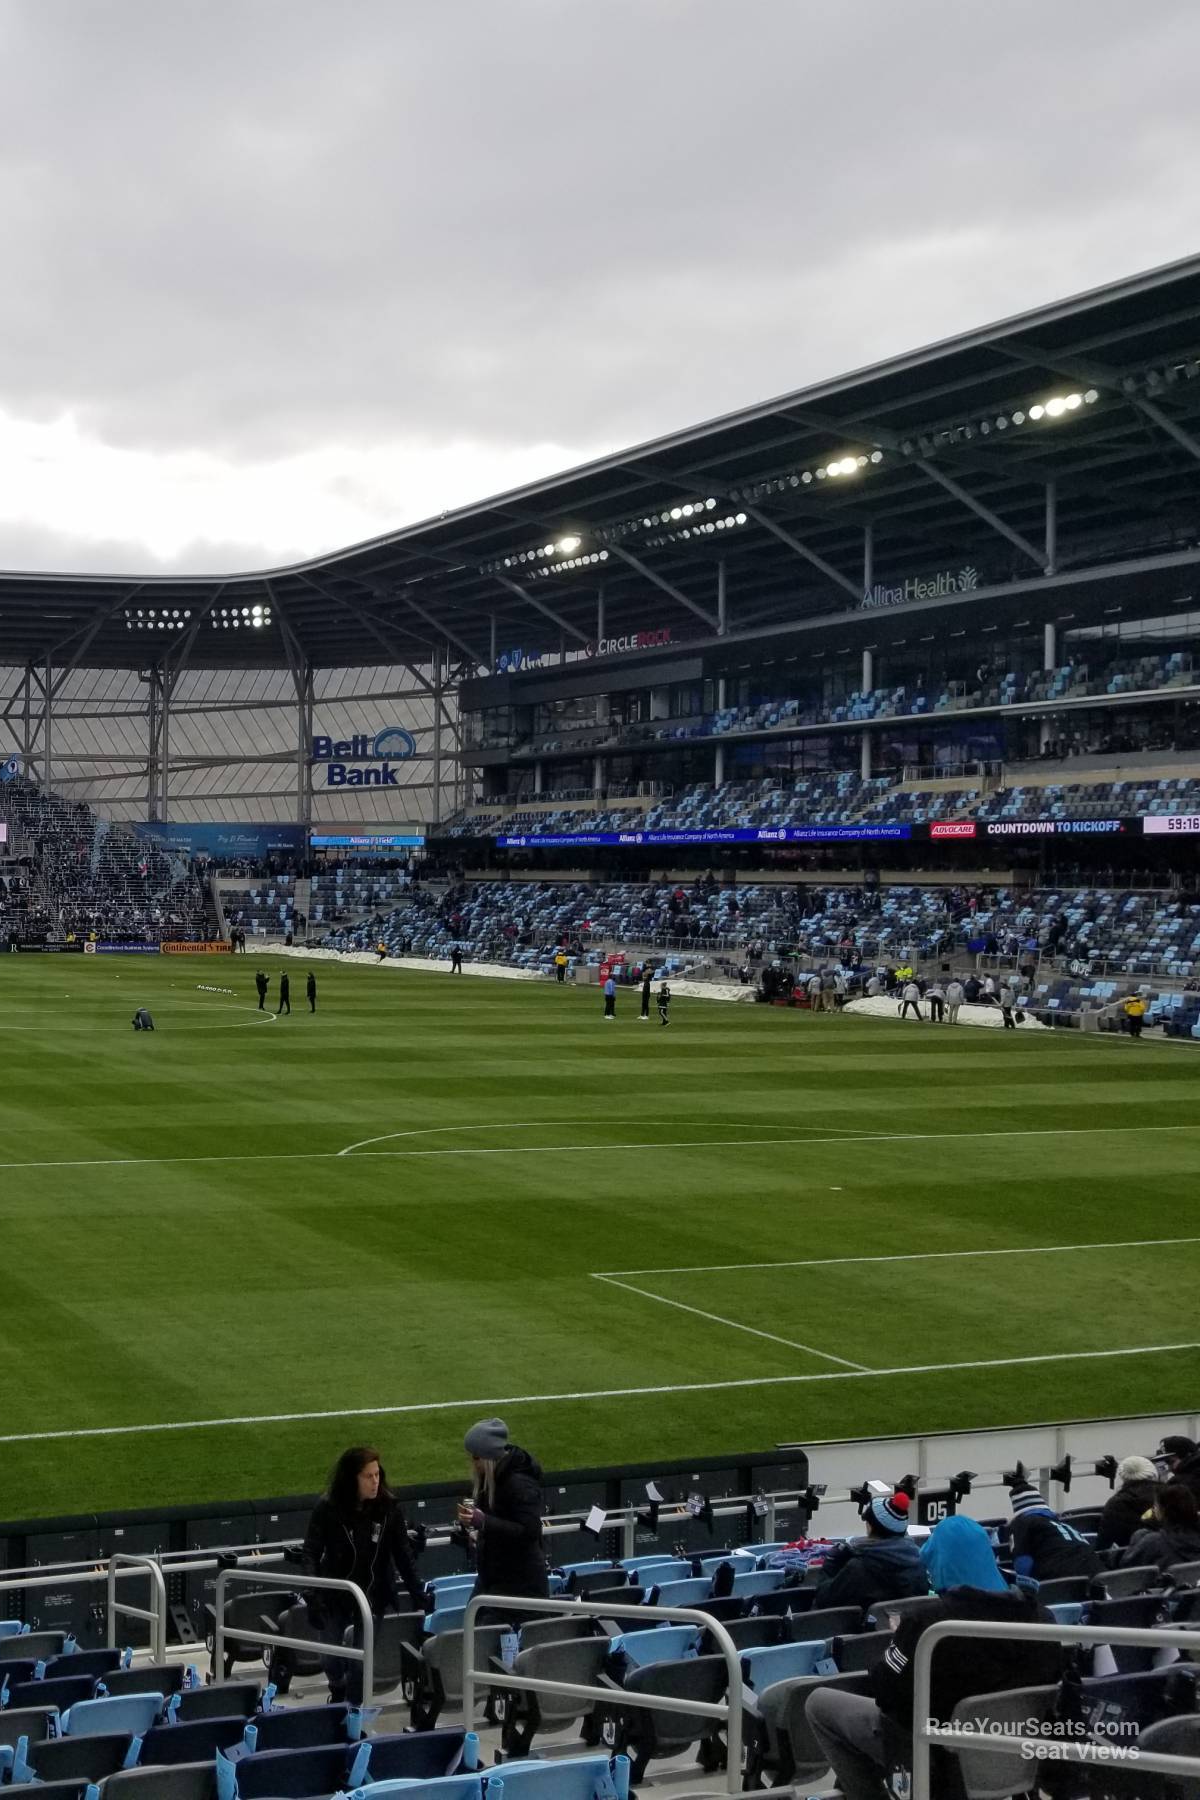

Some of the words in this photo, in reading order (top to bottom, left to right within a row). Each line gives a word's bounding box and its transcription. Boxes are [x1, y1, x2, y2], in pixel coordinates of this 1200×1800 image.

[905, 571, 957, 600] Health
[312, 734, 368, 759] Bell
[327, 762, 399, 786] Bank
[932, 824, 975, 835] ADVOCARE
[987, 823, 1055, 834] COUNTDOWN
[1056, 822, 1070, 833] TO
[1168, 818, 1200, 830] 59:16
[758, 830, 778, 838] Allianz
[839, 829, 860, 837] Company
[867, 828, 880, 836] North
[10, 943, 18, 953] R
[927, 1500, 948, 1522] 05
